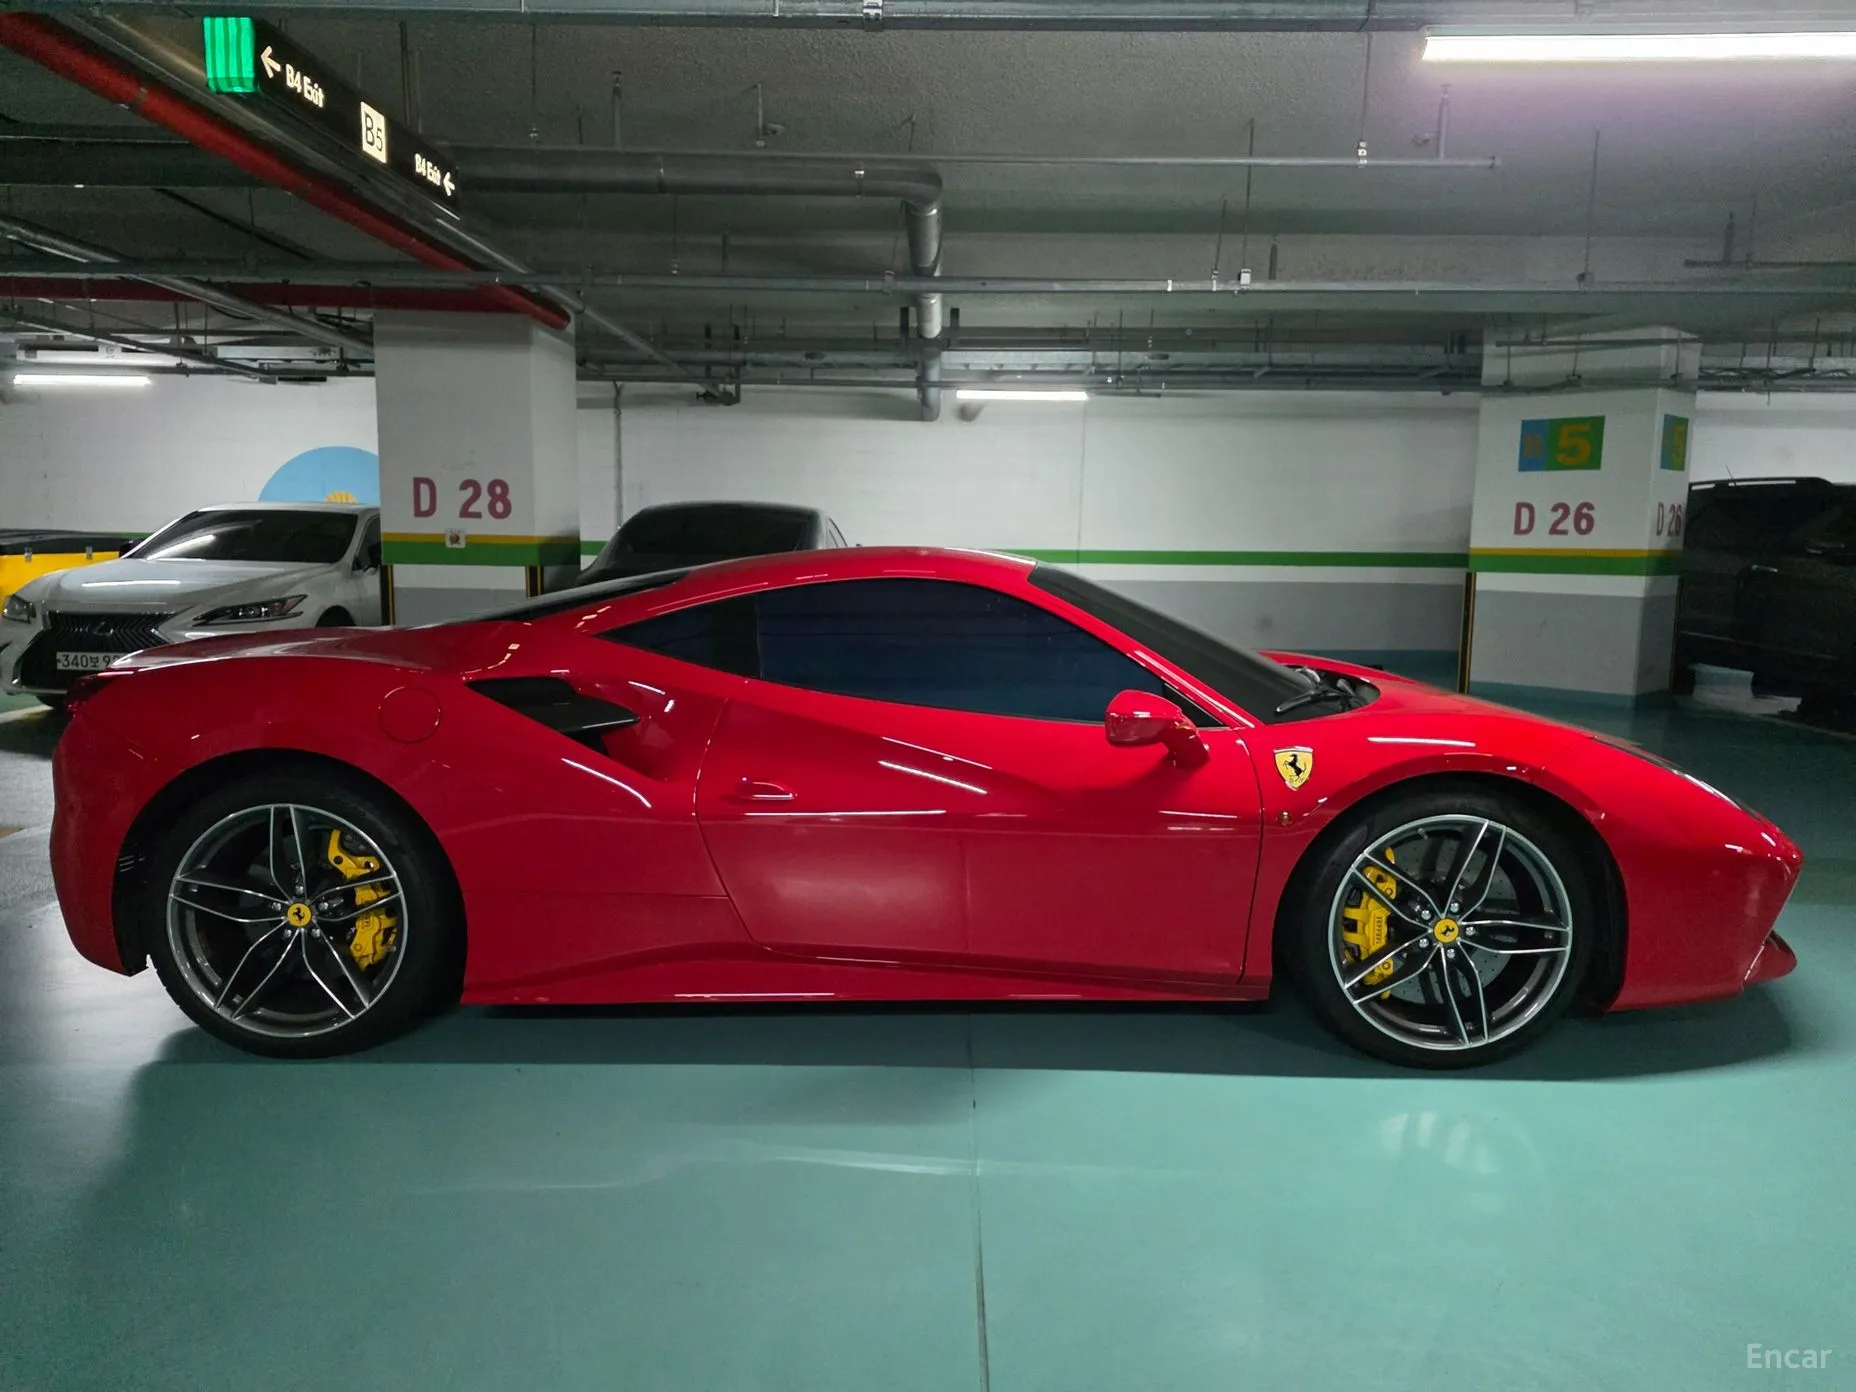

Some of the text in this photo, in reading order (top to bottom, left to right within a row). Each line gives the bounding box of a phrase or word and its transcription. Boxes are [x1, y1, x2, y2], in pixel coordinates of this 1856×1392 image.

[286, 64, 325, 108] B4 Exit
[365, 111, 383, 152] B5
[414, 153, 427, 176] B4
[413, 476, 512, 520] D 28
[1513, 502, 1596, 536] D 26
[1656, 502, 1683, 537] D 26
